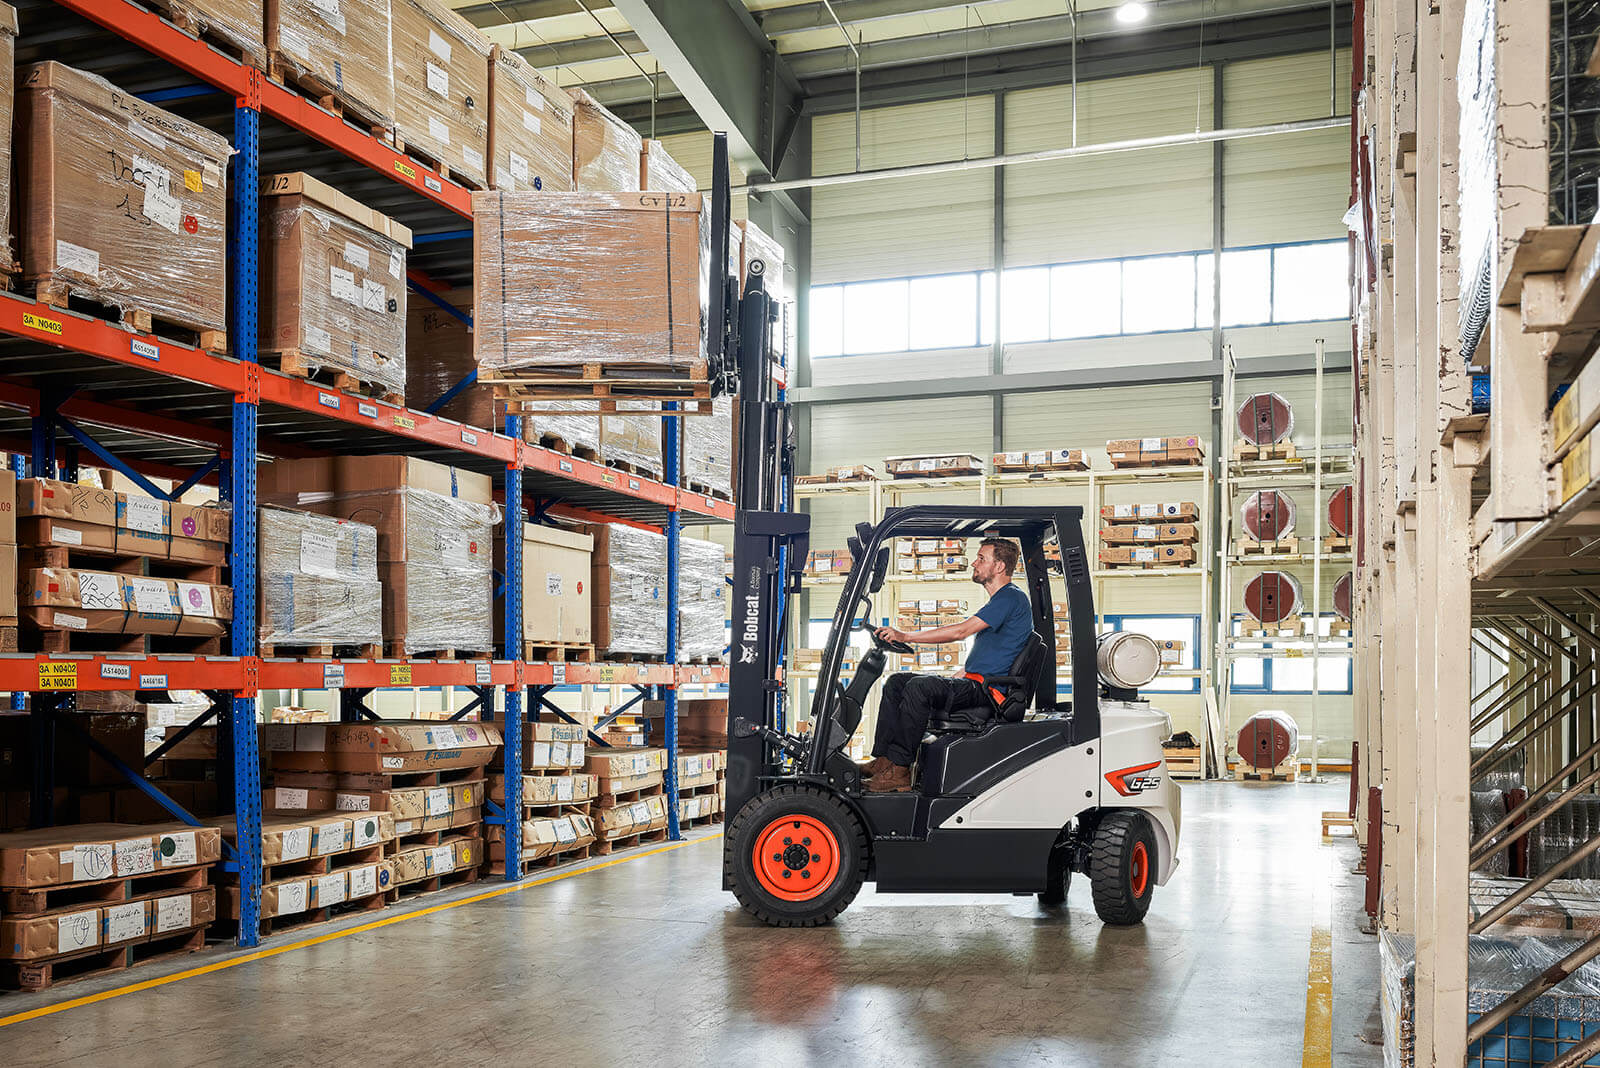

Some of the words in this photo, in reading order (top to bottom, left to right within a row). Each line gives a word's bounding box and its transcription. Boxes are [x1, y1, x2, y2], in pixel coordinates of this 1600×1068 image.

[271, 176, 289, 190] 1/2
[23, 314, 35, 325] 3A
[37, 318, 63, 333] N0403
[742, 594, 760, 642] Bobcat
[39, 665, 50, 674] 3A
[53, 665, 77, 673] N0402
[40, 678, 51, 687] 3A
[53, 678, 75, 687] N0401
[1130, 777, 1161, 791] G25
